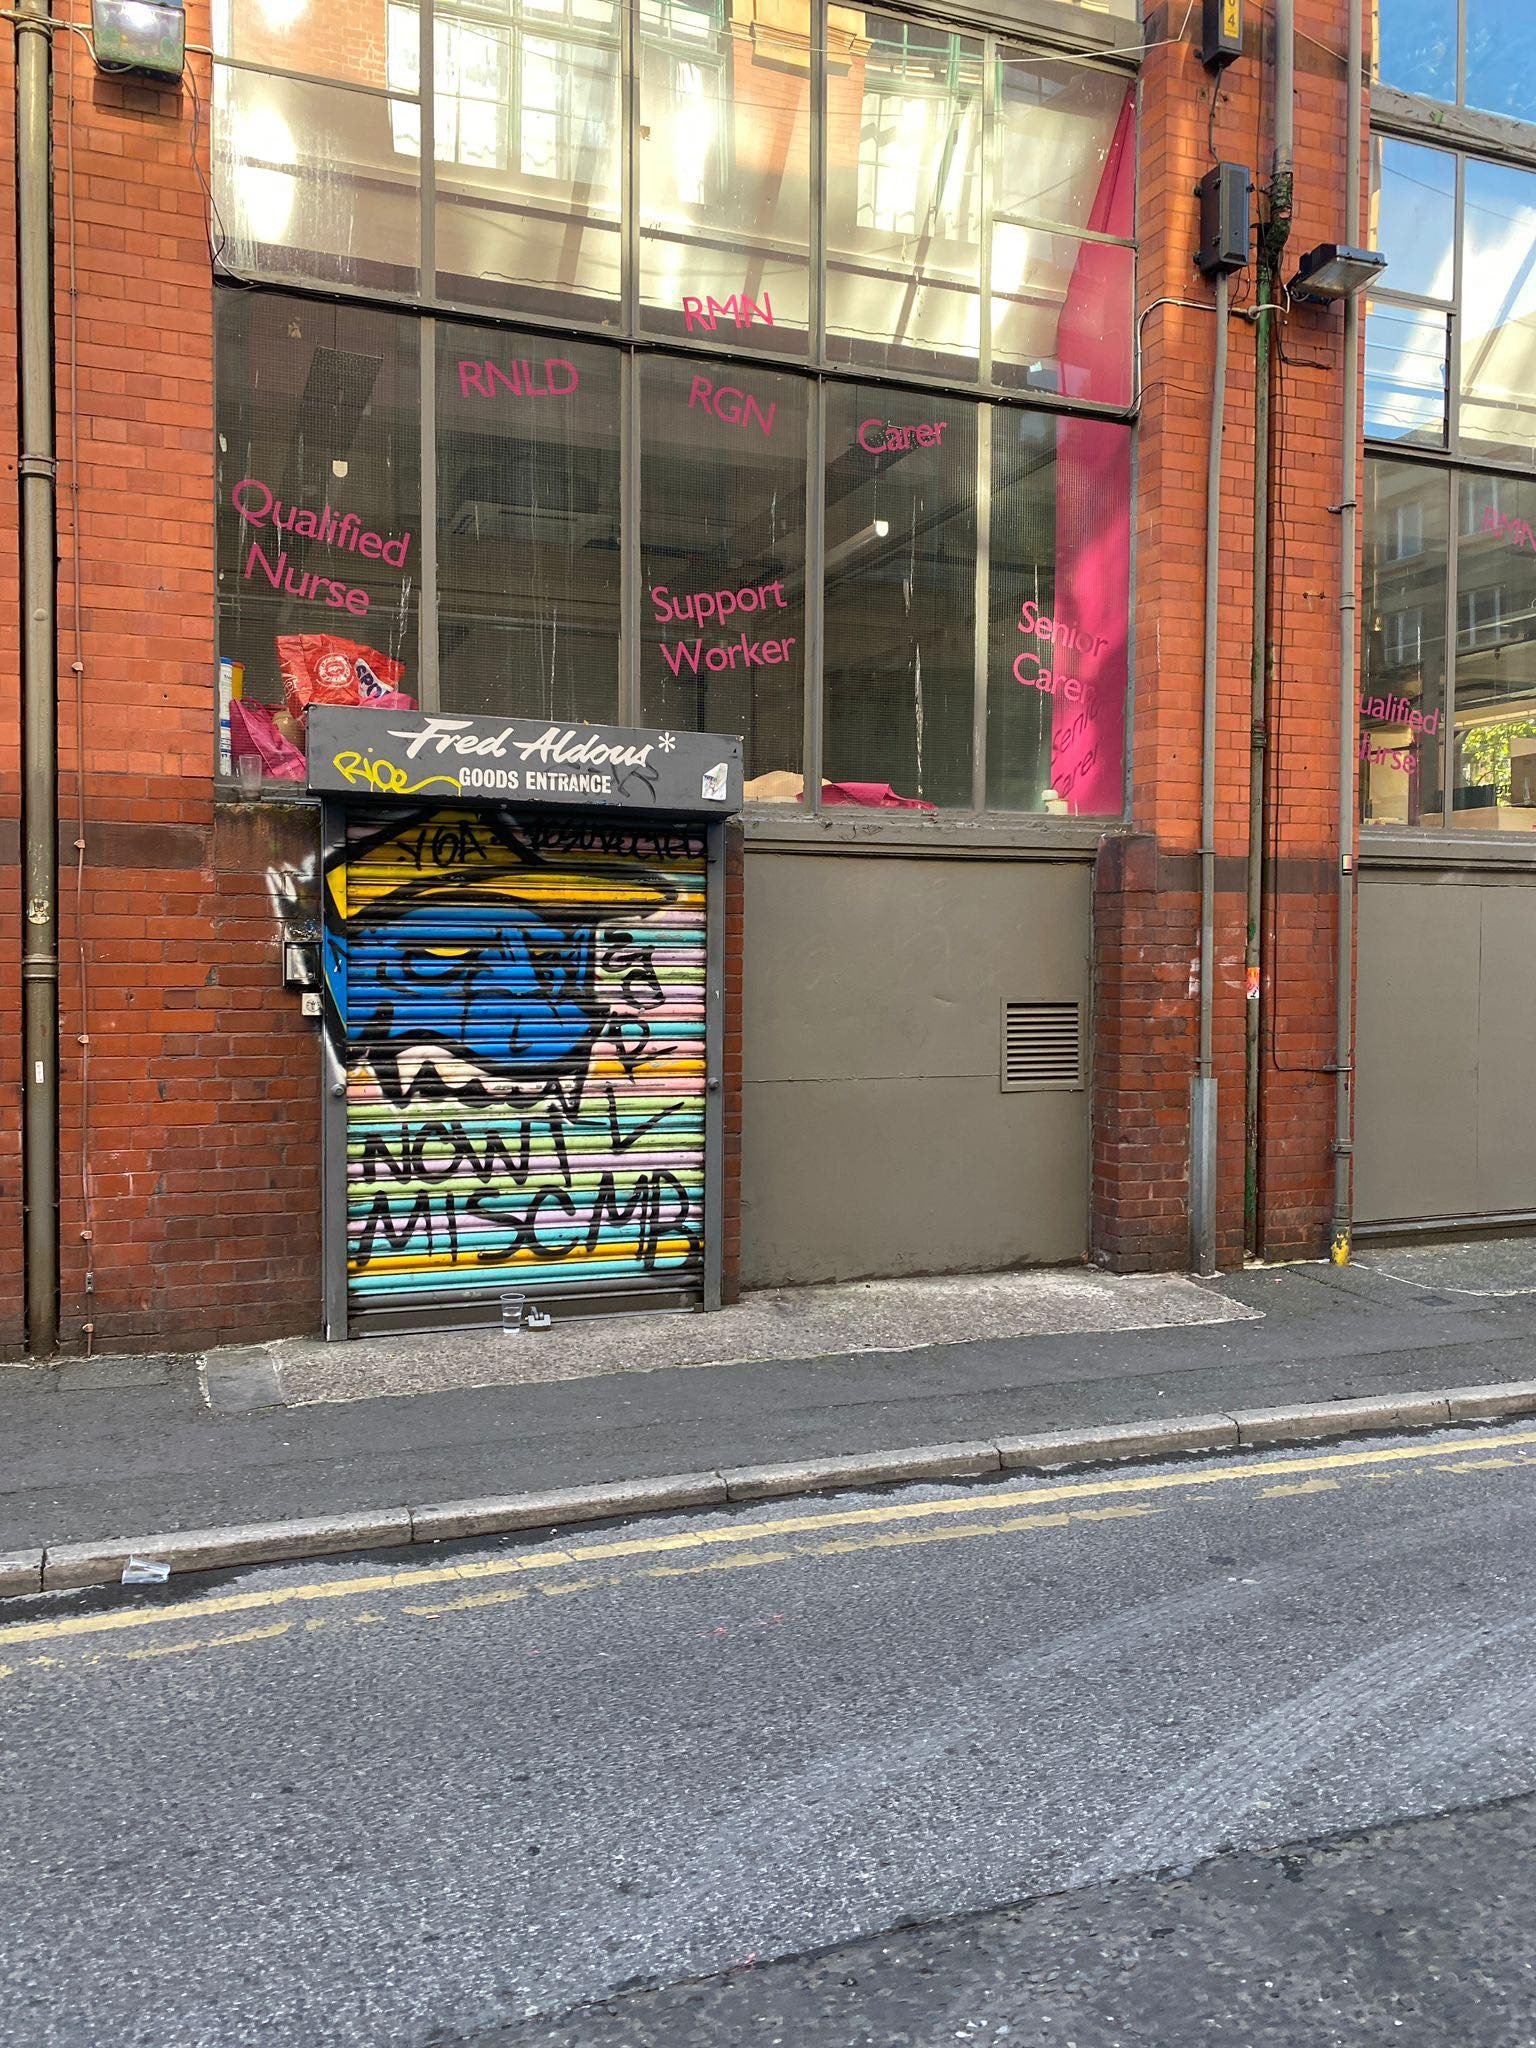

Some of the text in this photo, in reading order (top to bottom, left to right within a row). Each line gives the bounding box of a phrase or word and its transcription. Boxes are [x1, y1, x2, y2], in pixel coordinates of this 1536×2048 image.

[682, 292, 773, 333] RMN
[459, 359, 579, 398] RNLD
[689, 376, 776, 436] RGN
[858, 418, 947, 455] Carer
[232, 478, 411, 568] Qualified
[244, 542, 370, 616] Nurse
[651, 580, 788, 627] Support
[1018, 600, 1108, 656] Senior
[660, 633, 796, 676] Worker
[355, 664, 391, 699] SPO
[1013, 652, 1097, 706] Carer
[1359, 693, 1439, 735] ualified
[387, 717, 514, 759] Fred
[458, 767, 519, 789] GOODS
[525, 770, 612, 794] ENTRANCE
